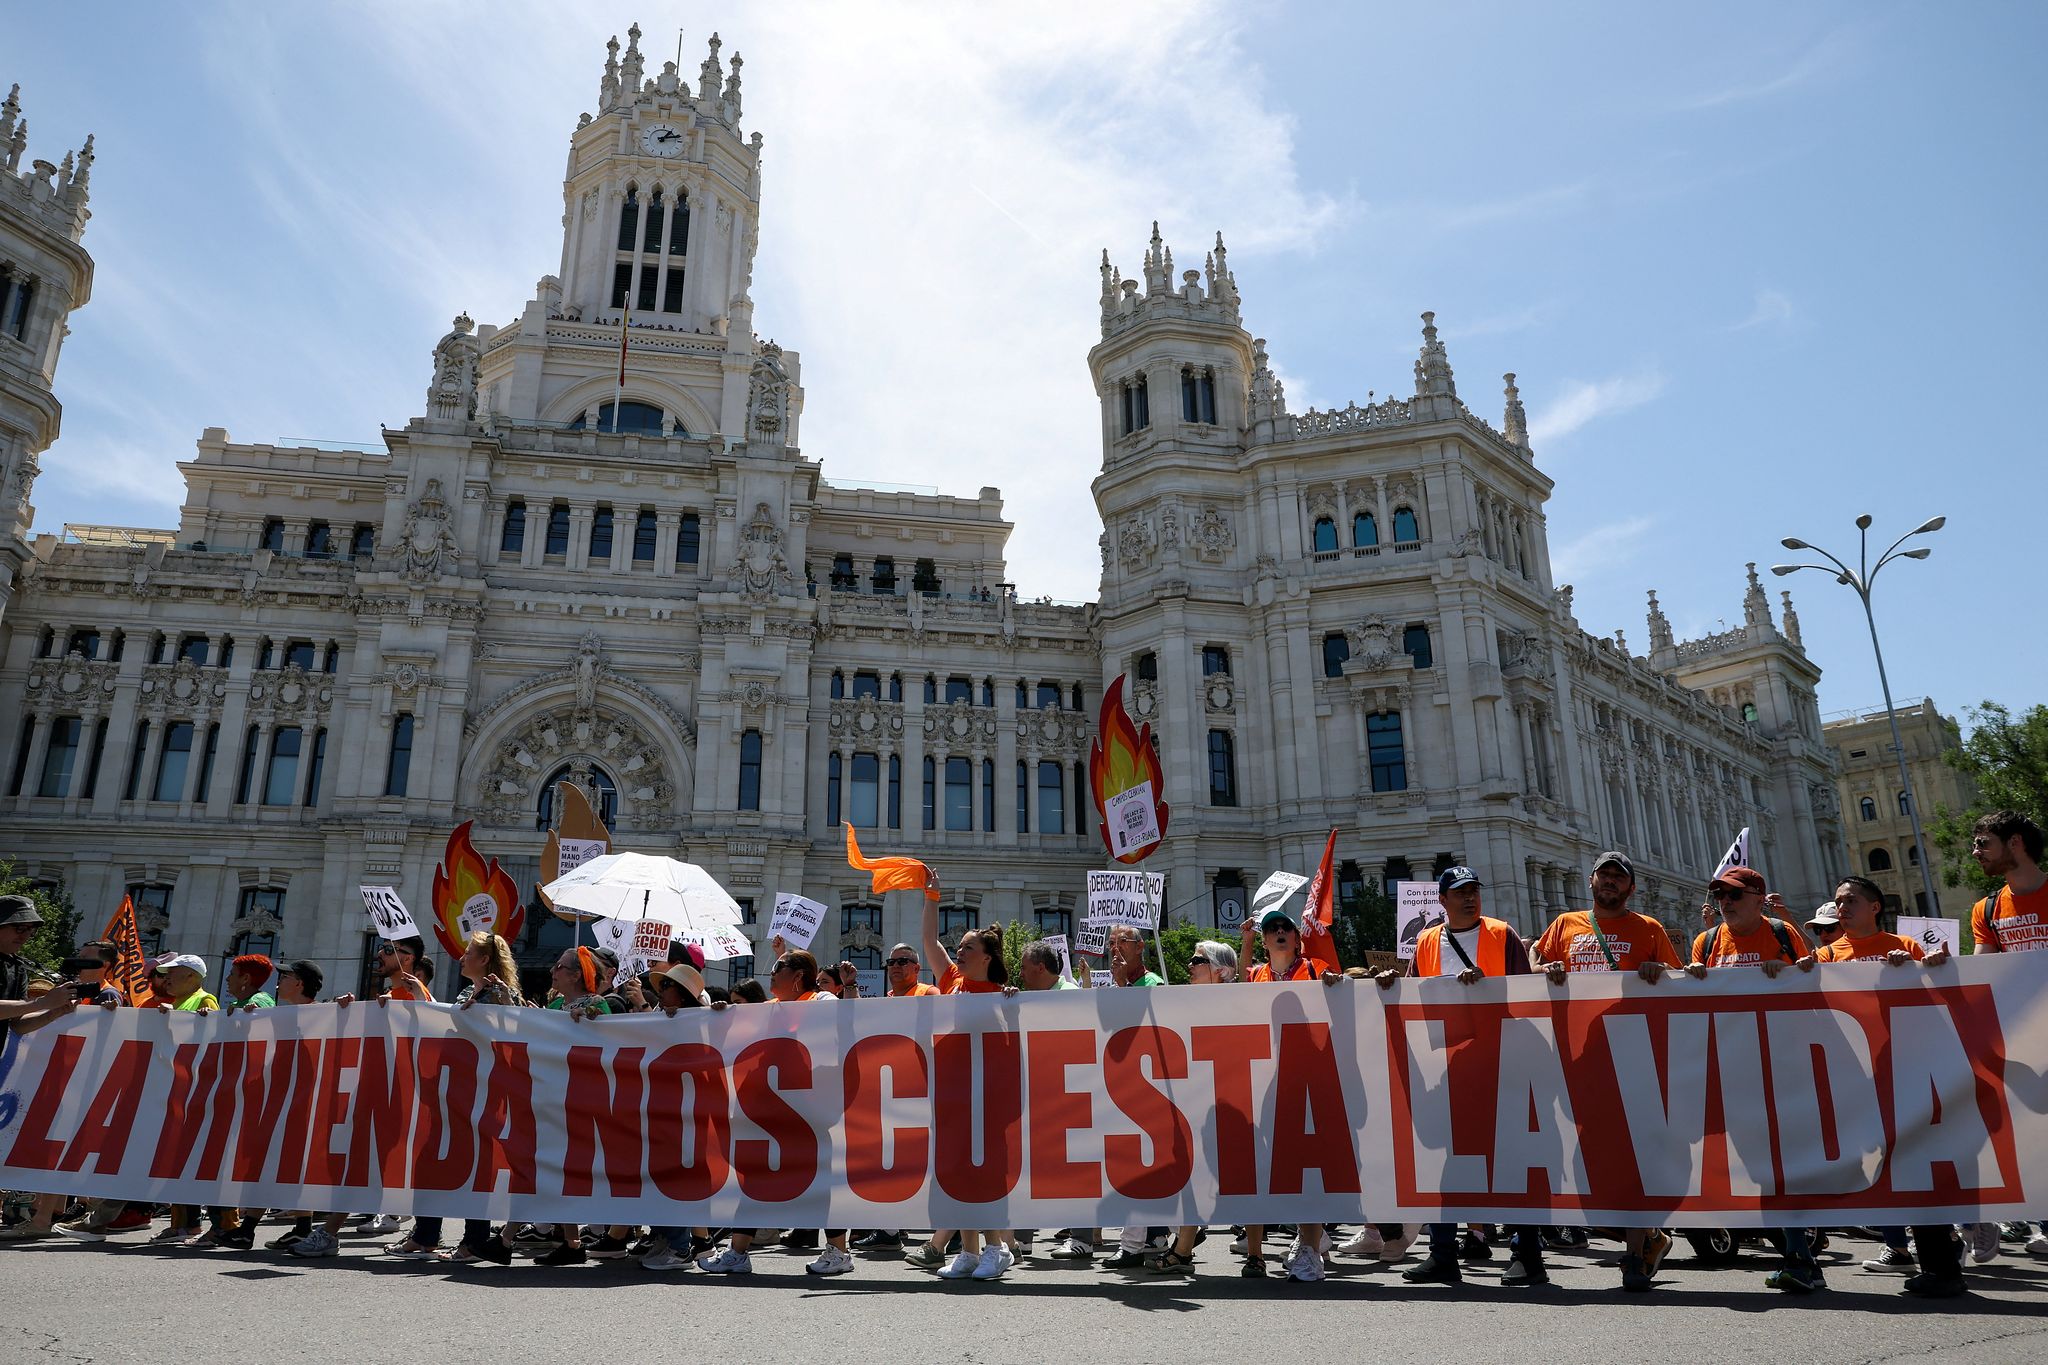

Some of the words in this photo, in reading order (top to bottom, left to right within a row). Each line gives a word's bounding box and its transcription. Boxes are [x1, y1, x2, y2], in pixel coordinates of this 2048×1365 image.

[560, 861, 575, 869] FRÍA
[1089, 875, 1126, 897] ¡DERECHO
[1126, 876, 1132, 893] A
[1090, 900, 1096, 918] A
[1096, 899, 1125, 917] PRECIO
[790, 909, 817, 927] gaviotas,
[1994, 913, 2039, 929] SINDICATO
[786, 922, 810, 938] explotan.
[4, 1034, 153, 1176] LA
[148, 1036, 537, 1196] VIVIENDA
[562, 1037, 819, 1203] NOS
[843, 1023, 1361, 1203] CUESTA
[1404, 1015, 1591, 1195] LA
[1602, 1004, 2006, 1198] VIDA
